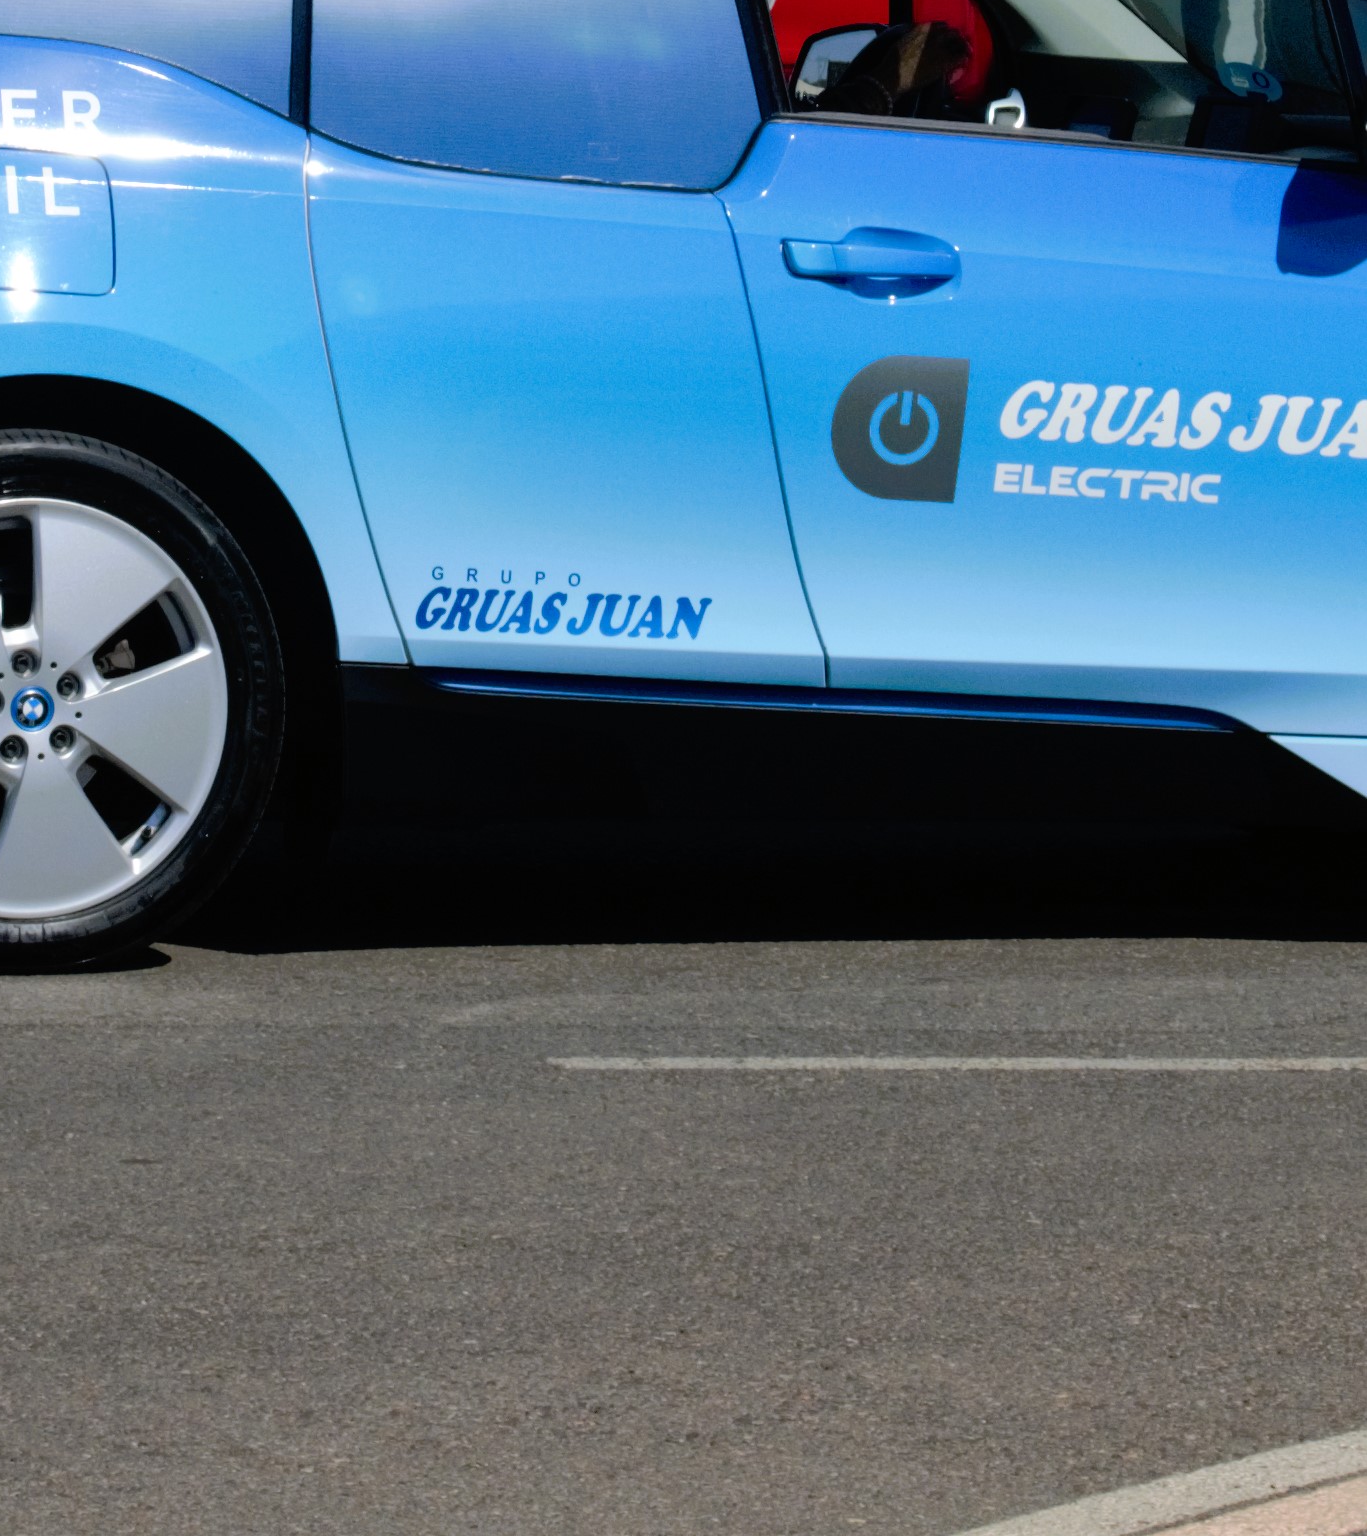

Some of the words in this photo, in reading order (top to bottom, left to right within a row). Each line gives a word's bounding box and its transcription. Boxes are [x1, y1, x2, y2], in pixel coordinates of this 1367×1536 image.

[998, 379, 1232, 450] GRUAS
[993, 462, 1222, 505] ELECTRIC
[431, 565, 582, 587] GRUPO
[414, 585, 568, 636] GRUAS
[566, 592, 713, 641] JUAN
